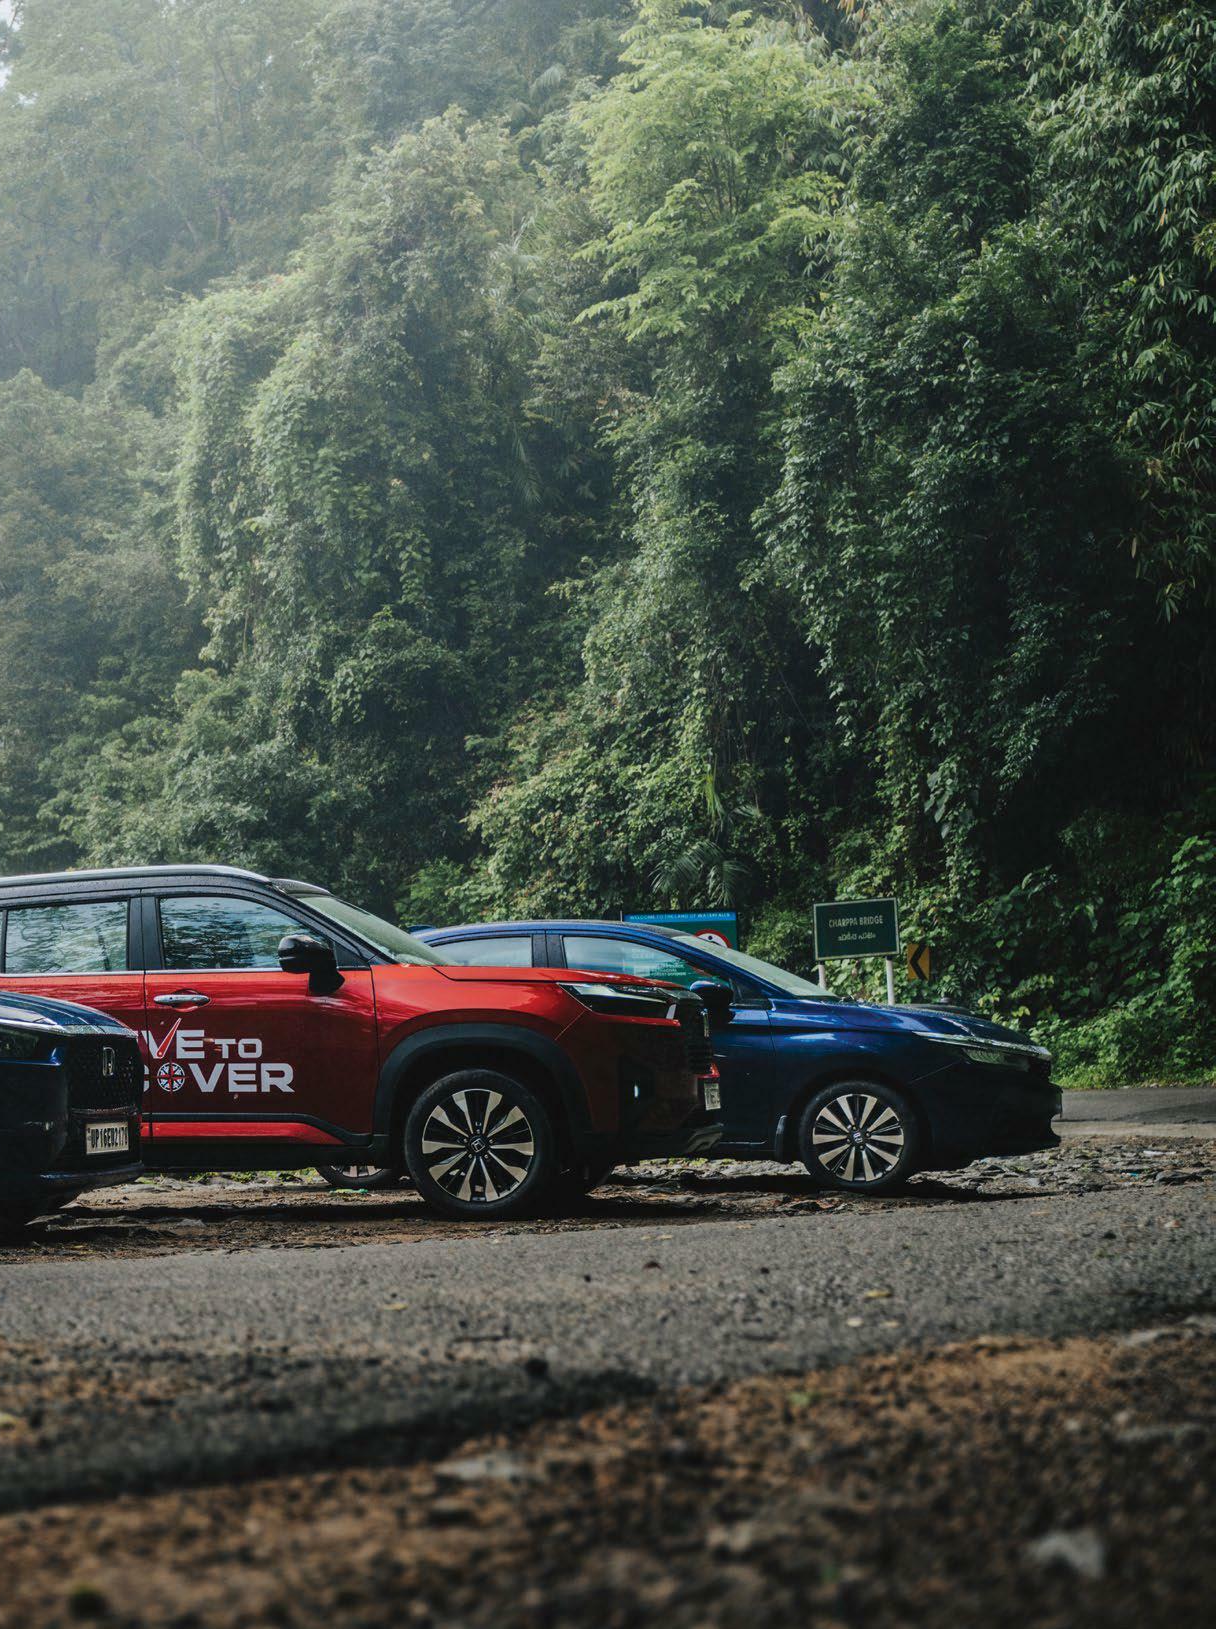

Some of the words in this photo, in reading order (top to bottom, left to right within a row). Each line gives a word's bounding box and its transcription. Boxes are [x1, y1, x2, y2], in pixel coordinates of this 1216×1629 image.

[829, 917, 858, 928] CHARPPA
[859, 914, 883, 926] BRIDGE
[136, 1018, 205, 1059] VE
[214, 1038, 263, 1059] TO
